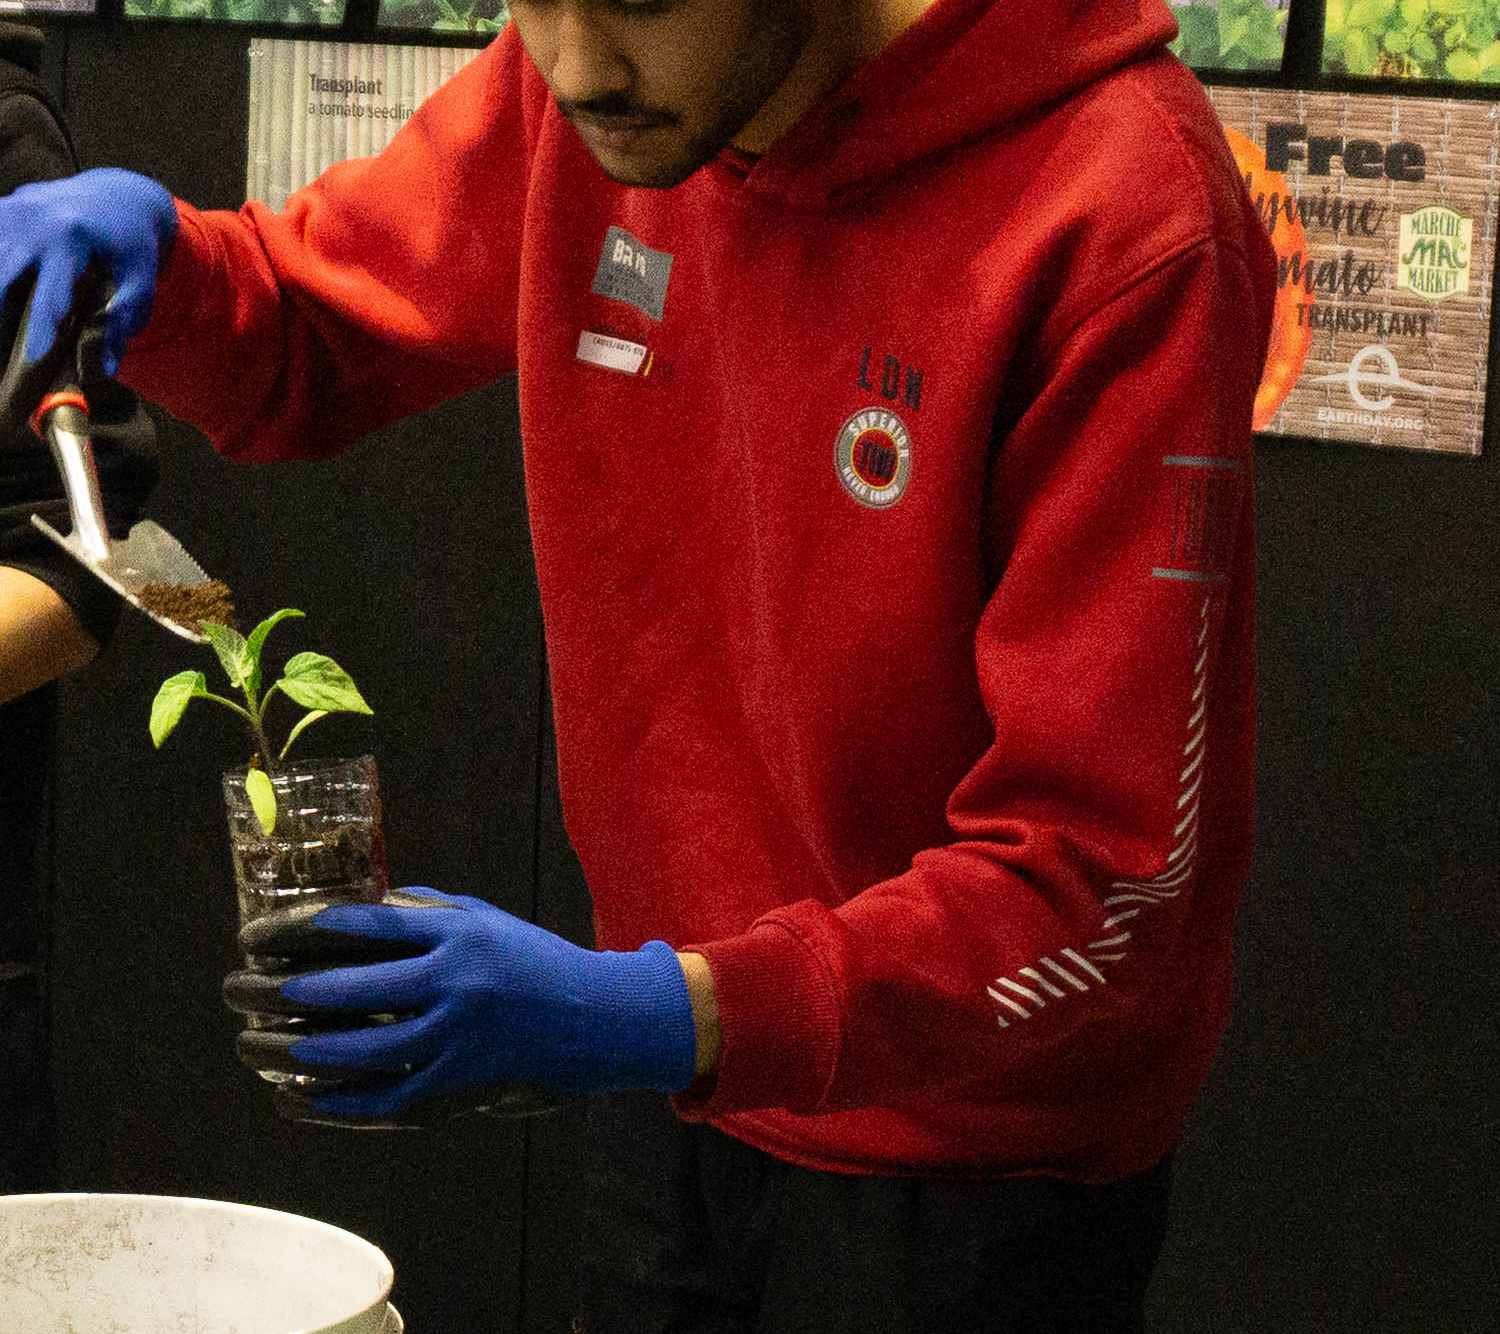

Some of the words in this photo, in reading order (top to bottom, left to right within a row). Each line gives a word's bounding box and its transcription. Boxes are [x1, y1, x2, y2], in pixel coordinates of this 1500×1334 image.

[308, 73, 383, 96] Transplant
[308, 102, 317, 116] a
[319, 101, 365, 118] tomato
[366, 102, 415, 121] seedlin
[1264, 121, 1428, 183] Free
[1245, 171, 1388, 236] ywine
[1411, 211, 1463, 237] MARCHE
[1401, 237, 1468, 270] MAC
[1277, 249, 1386, 297] mato
[1407, 267, 1459, 293] MARKET
[1296, 302, 1430, 337] TRANSPLANT
[856, 345, 925, 412] LDN
[848, 411, 910, 458] SUPERIOR
[1316, 408, 1424, 432] EARTHDAY.ORG
